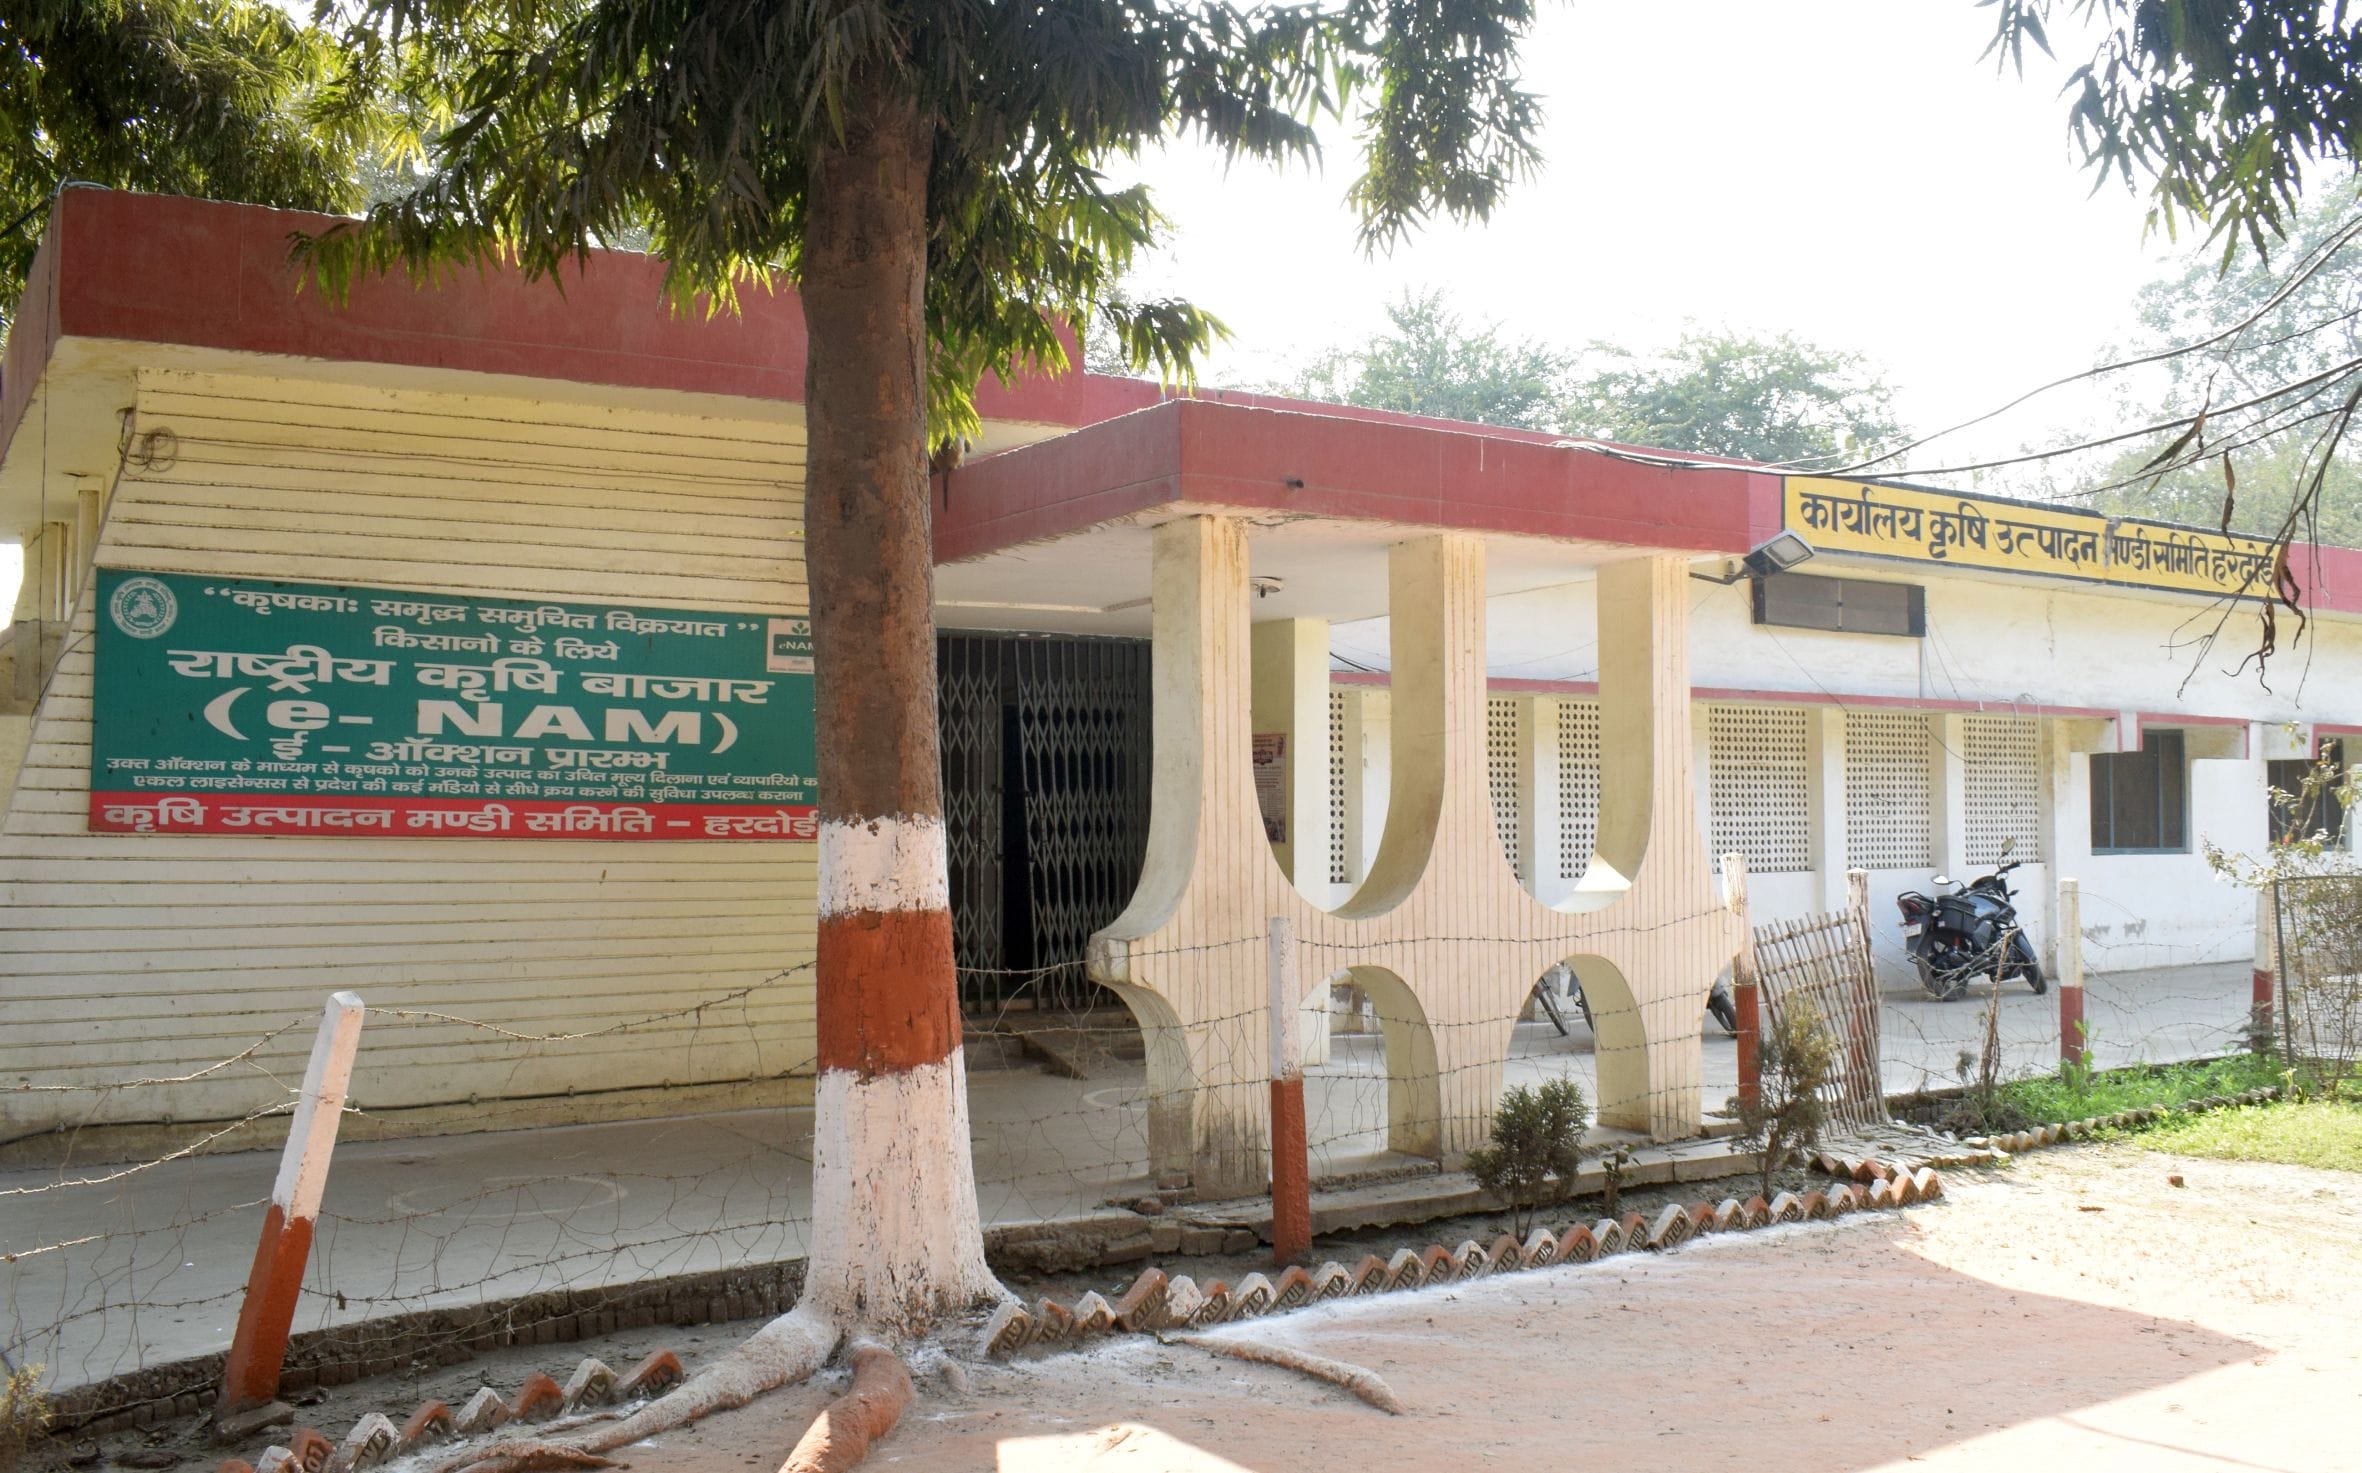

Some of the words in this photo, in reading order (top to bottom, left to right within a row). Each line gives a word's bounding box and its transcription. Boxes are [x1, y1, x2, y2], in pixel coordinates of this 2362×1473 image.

[1799, 486, 1924, 541] कार्यालय
[1929, 501, 1990, 558] कृषि
[1992, 519, 2098, 569] उत्पादन
[2152, 532, 2209, 577] समिति
[371, 600, 470, 626] समृद्ध
[477, 606, 597, 633] समुचित
[605, 611, 727, 637] विक्रयात
[509, 636, 545, 658] के
[554, 636, 621, 661] लिये
[166, 644, 397, 694] राष्ट्रीय
[414, 657, 563, 702] कृषि
[580, 672, 776, 704] बाजार
[270, 731, 308, 761] ई
[365, 737, 535, 766] ऑक्शन
[544, 747, 671, 770] प्रारम्भ
[106, 757, 151, 770] उक्त
[231, 757, 252, 771] के
[256, 761, 318, 774] माध्यम
[322, 760, 340, 774] से
[404, 763, 430, 777] को
[434, 765, 480, 778] उनके
[484, 768, 534, 780] उत्पाद
[537, 770, 561, 781] का
[564, 768, 607, 782] उचित
[610, 772, 646, 787] मूल्य
[650, 770, 704, 785] दिलाना
[133, 775, 186, 787] एकल
[292, 775, 310, 790] से
[314, 776, 358, 791] प्रदेश
[361, 777, 388, 792] की
[391, 778, 425, 793] कई
[485, 781, 502, 795] से
[505, 781, 541, 795] सीधे
[579, 785, 619, 797] करने
[622, 784, 646, 798] की
[649, 785, 697, 803] सुविधा
[757, 790, 804, 801] कराना
[102, 796, 209, 833] कृषि
[220, 806, 396, 828] उत्पादन
[405, 803, 515, 832] मण्डी
[524, 805, 656, 833] समिति
